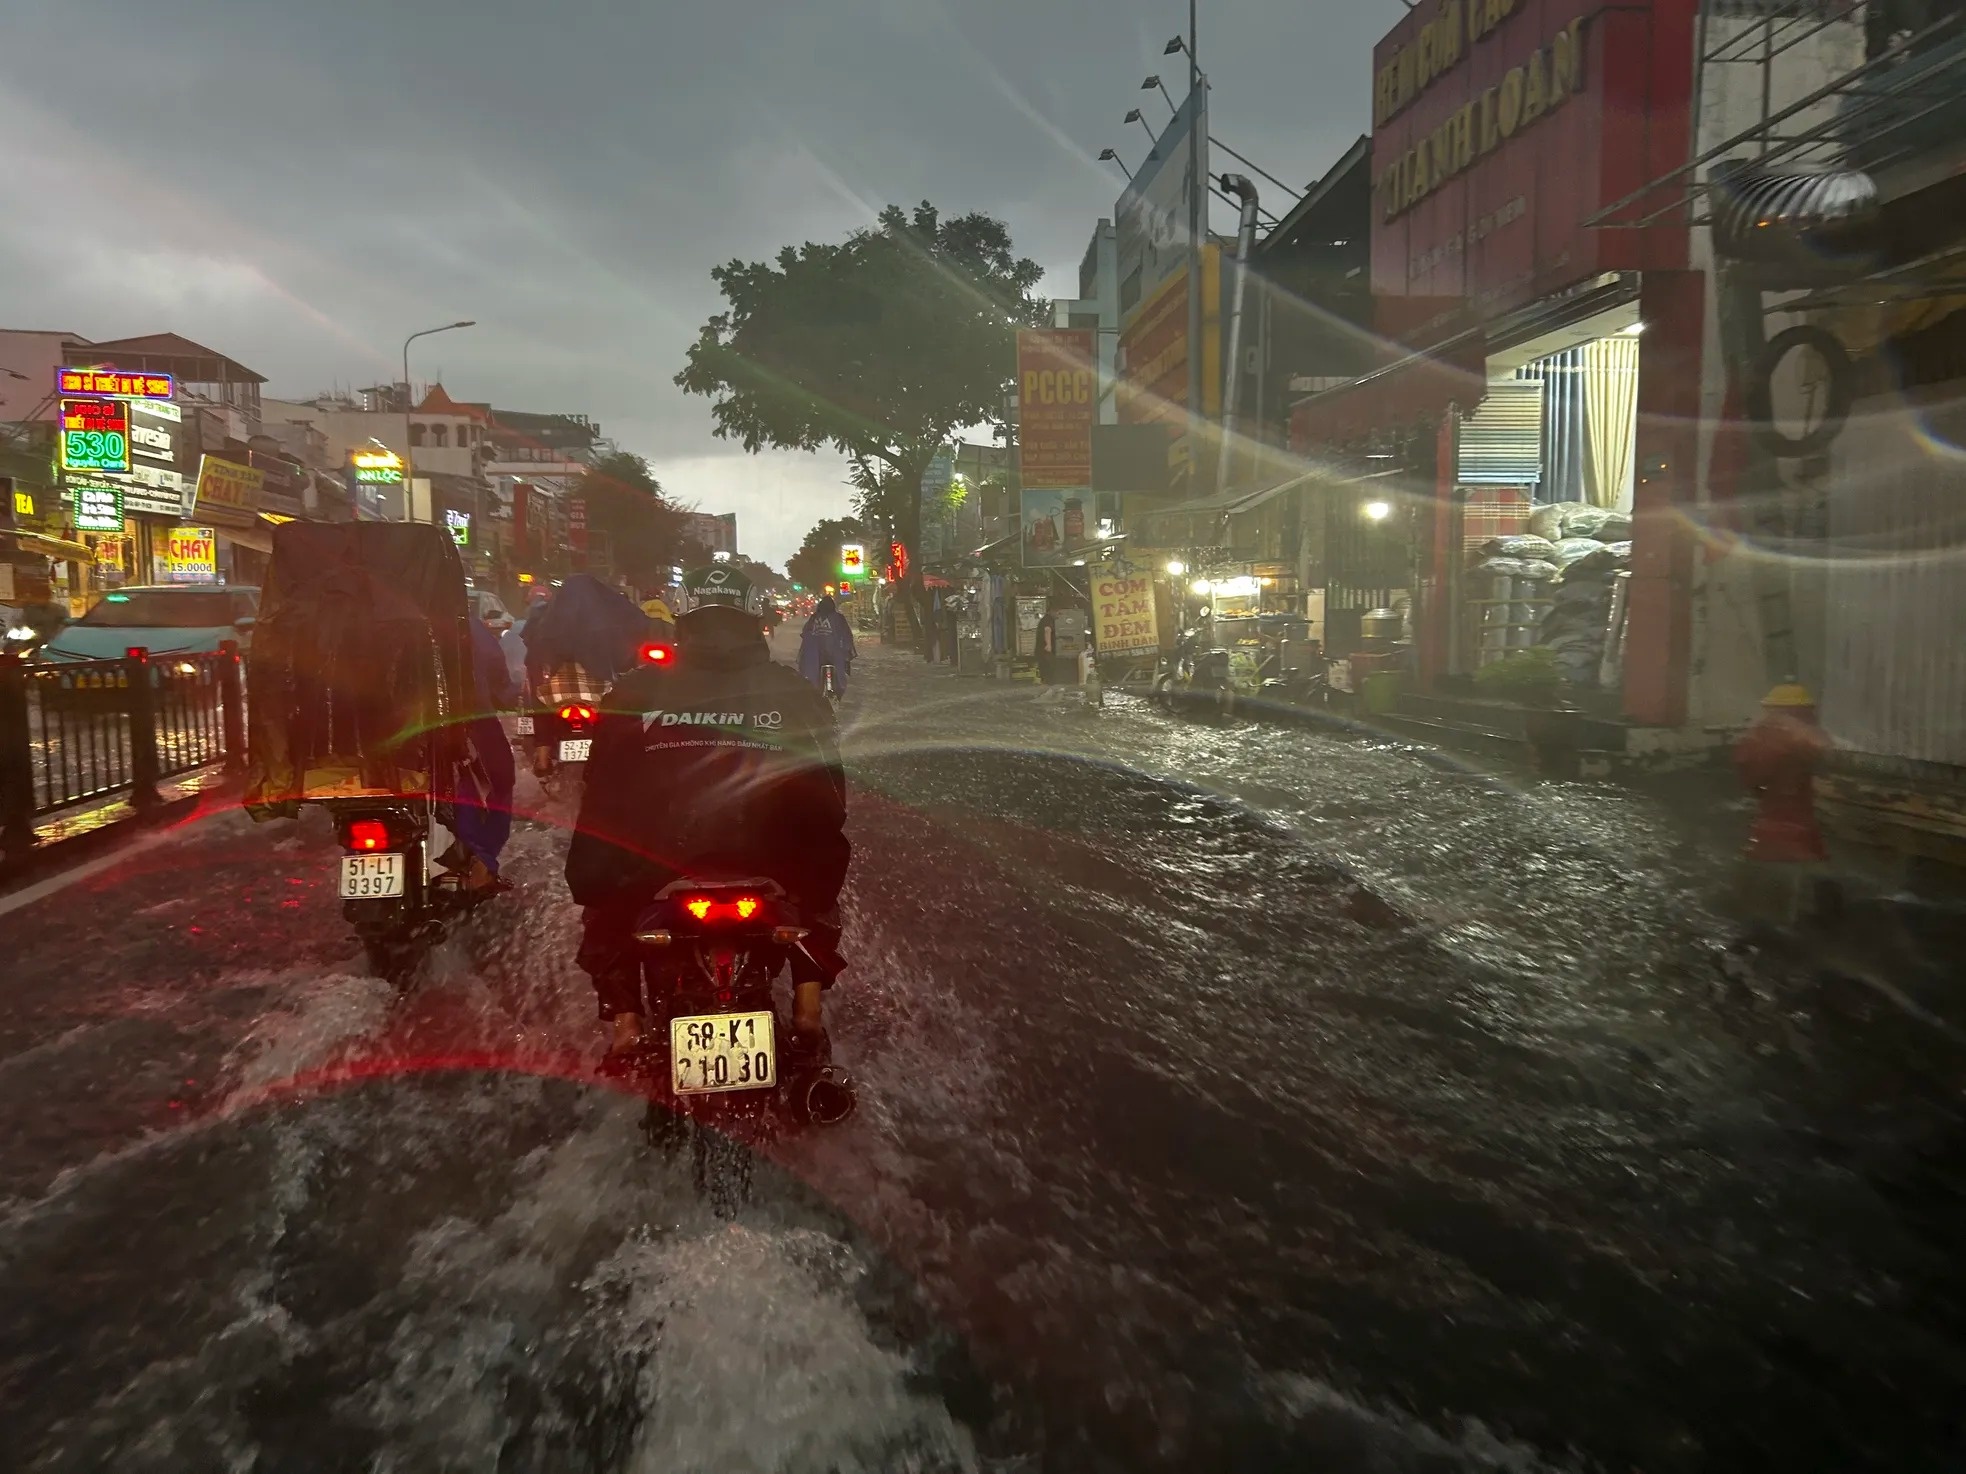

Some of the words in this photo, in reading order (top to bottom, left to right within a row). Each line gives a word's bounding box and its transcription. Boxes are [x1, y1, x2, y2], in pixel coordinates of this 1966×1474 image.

[1479, 16, 1584, 156] LOAN
[1024, 370, 1089, 405] PCCC
[66, 431, 125, 458] 530
[14, 493, 35, 516] TEA
[169, 540, 213, 561] CHAY
[693, 586, 741, 597] Nagakawa
[1101, 594, 1151, 618] TẤM
[1103, 618, 1153, 639] ĐÊM
[661, 712, 744, 727] DAIKIN
[753, 710, 782, 727] 100
[349, 857, 393, 876] 51-L1
[348, 876, 395, 895] 9397
